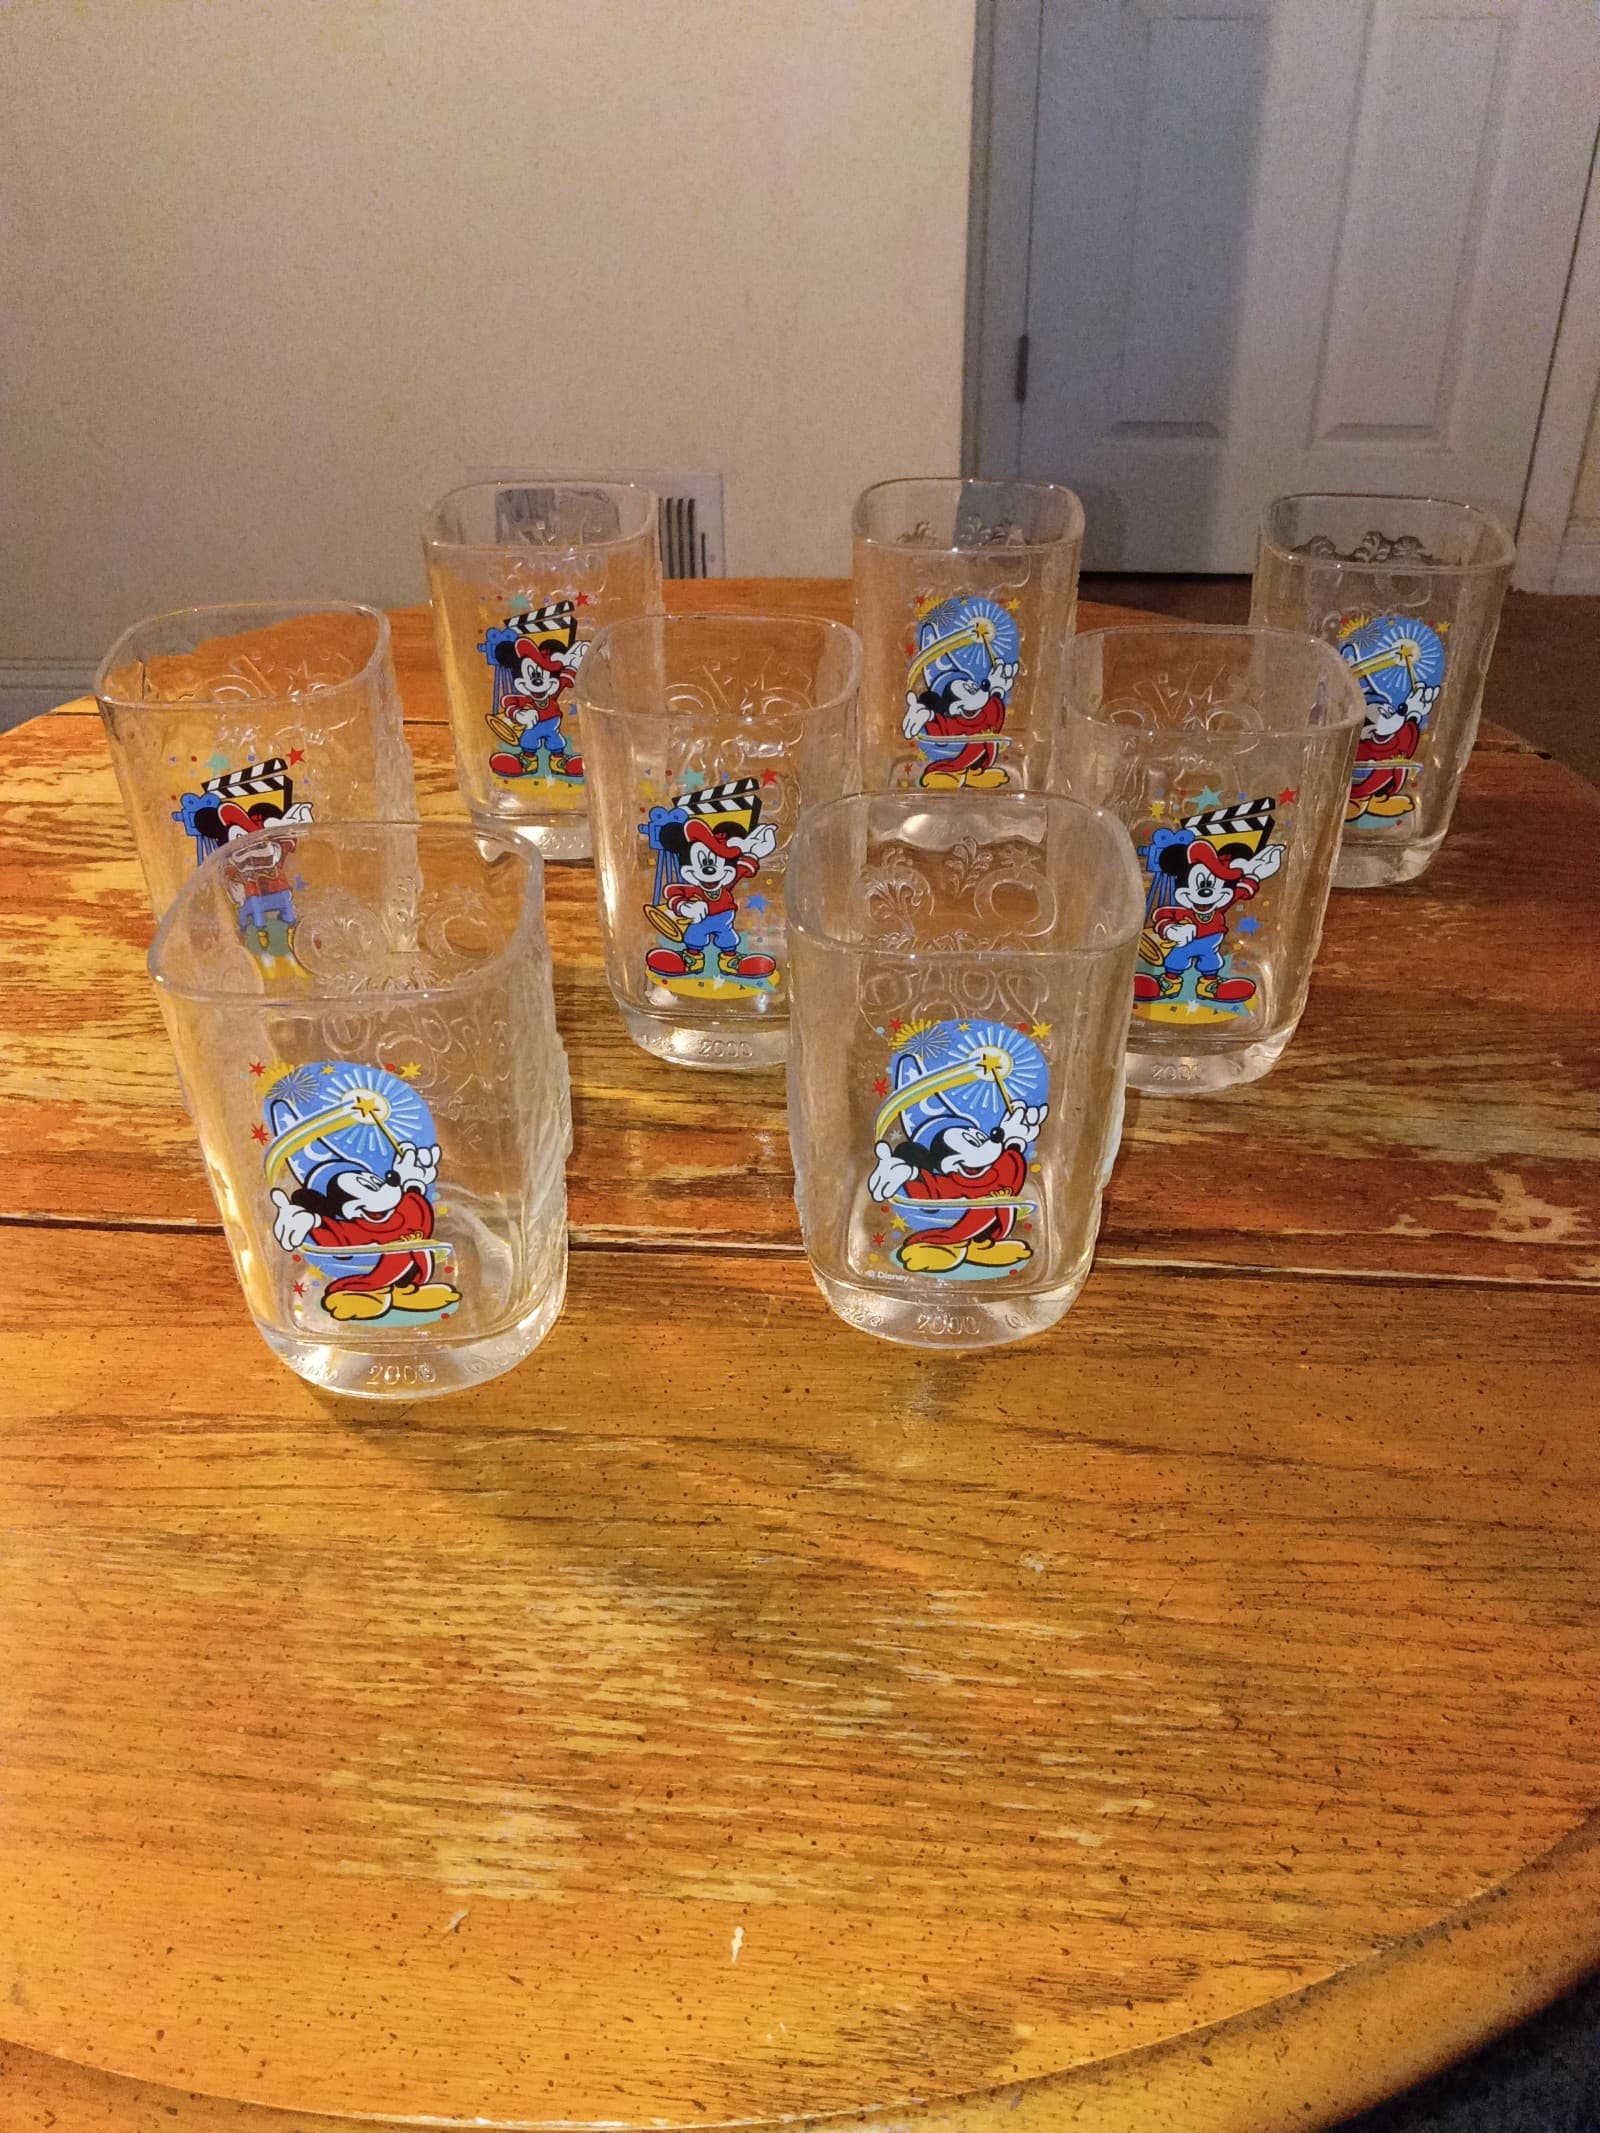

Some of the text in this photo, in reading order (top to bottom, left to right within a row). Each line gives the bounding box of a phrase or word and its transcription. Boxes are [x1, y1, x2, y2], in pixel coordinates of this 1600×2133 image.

[877, 1271, 910, 1283] Disney
[914, 1313, 981, 1336] 2000
[366, 1362, 438, 1386] 2000
